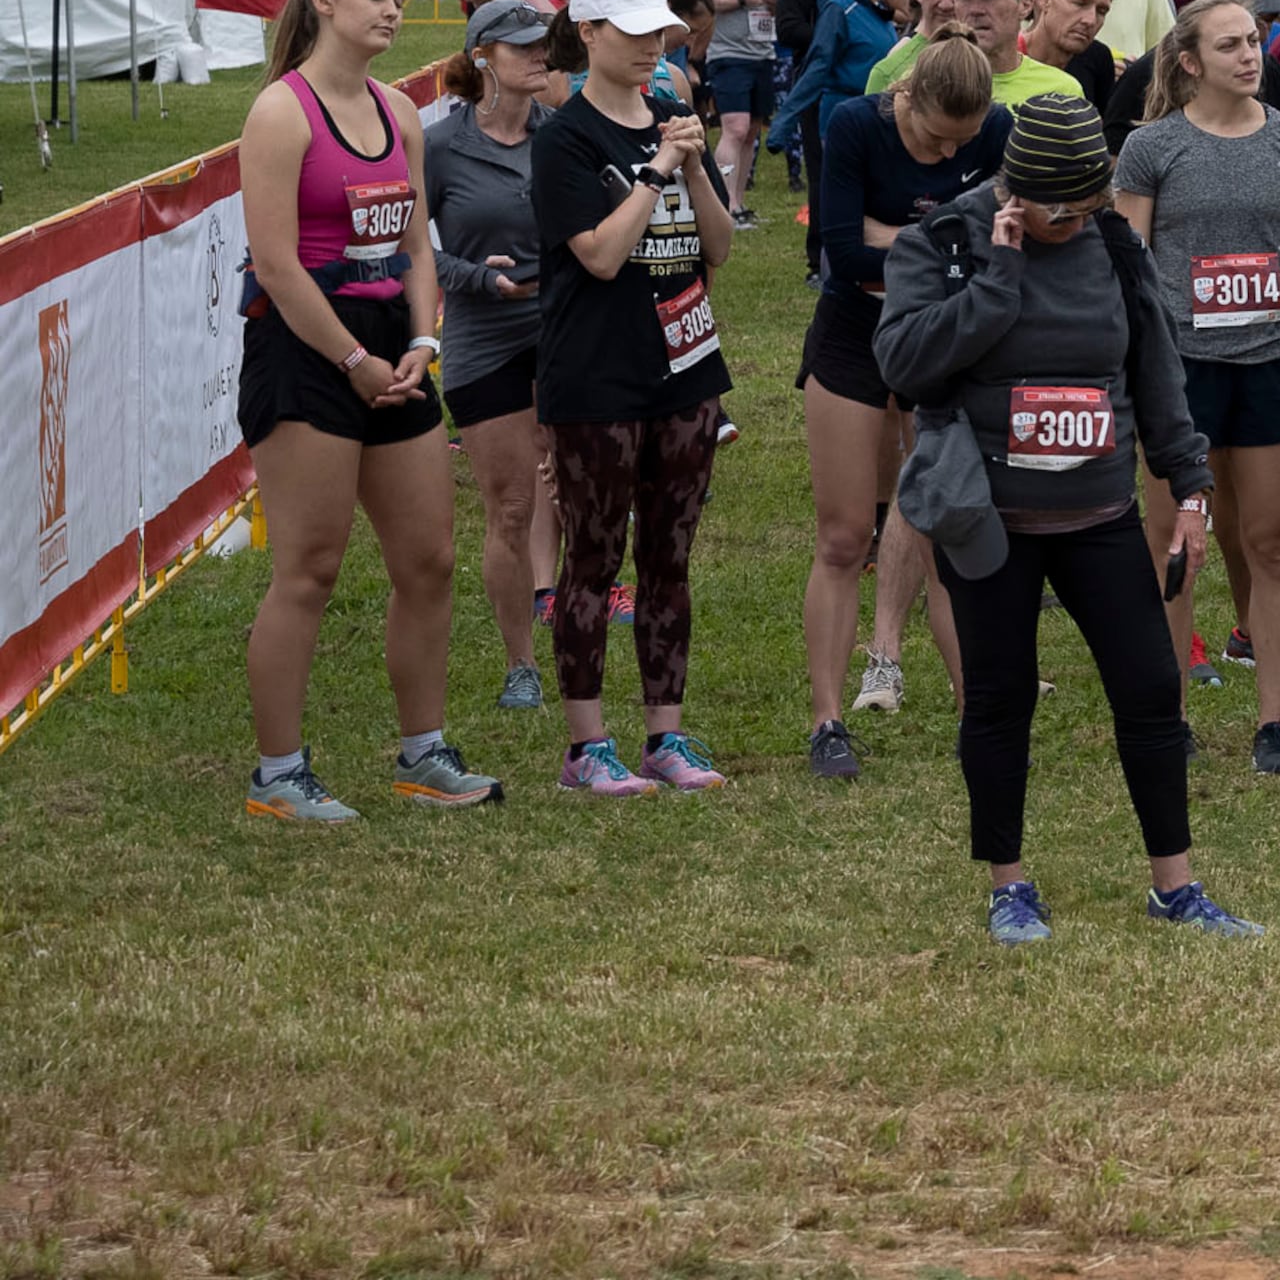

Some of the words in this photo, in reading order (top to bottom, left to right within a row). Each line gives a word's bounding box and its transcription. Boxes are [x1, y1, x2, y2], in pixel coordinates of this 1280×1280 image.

[368, 200, 415, 237] 3097
[630, 236, 701, 259] HAMILTO
[1216, 272, 1280, 305] 3014
[1037, 411, 1110, 447] 3007
